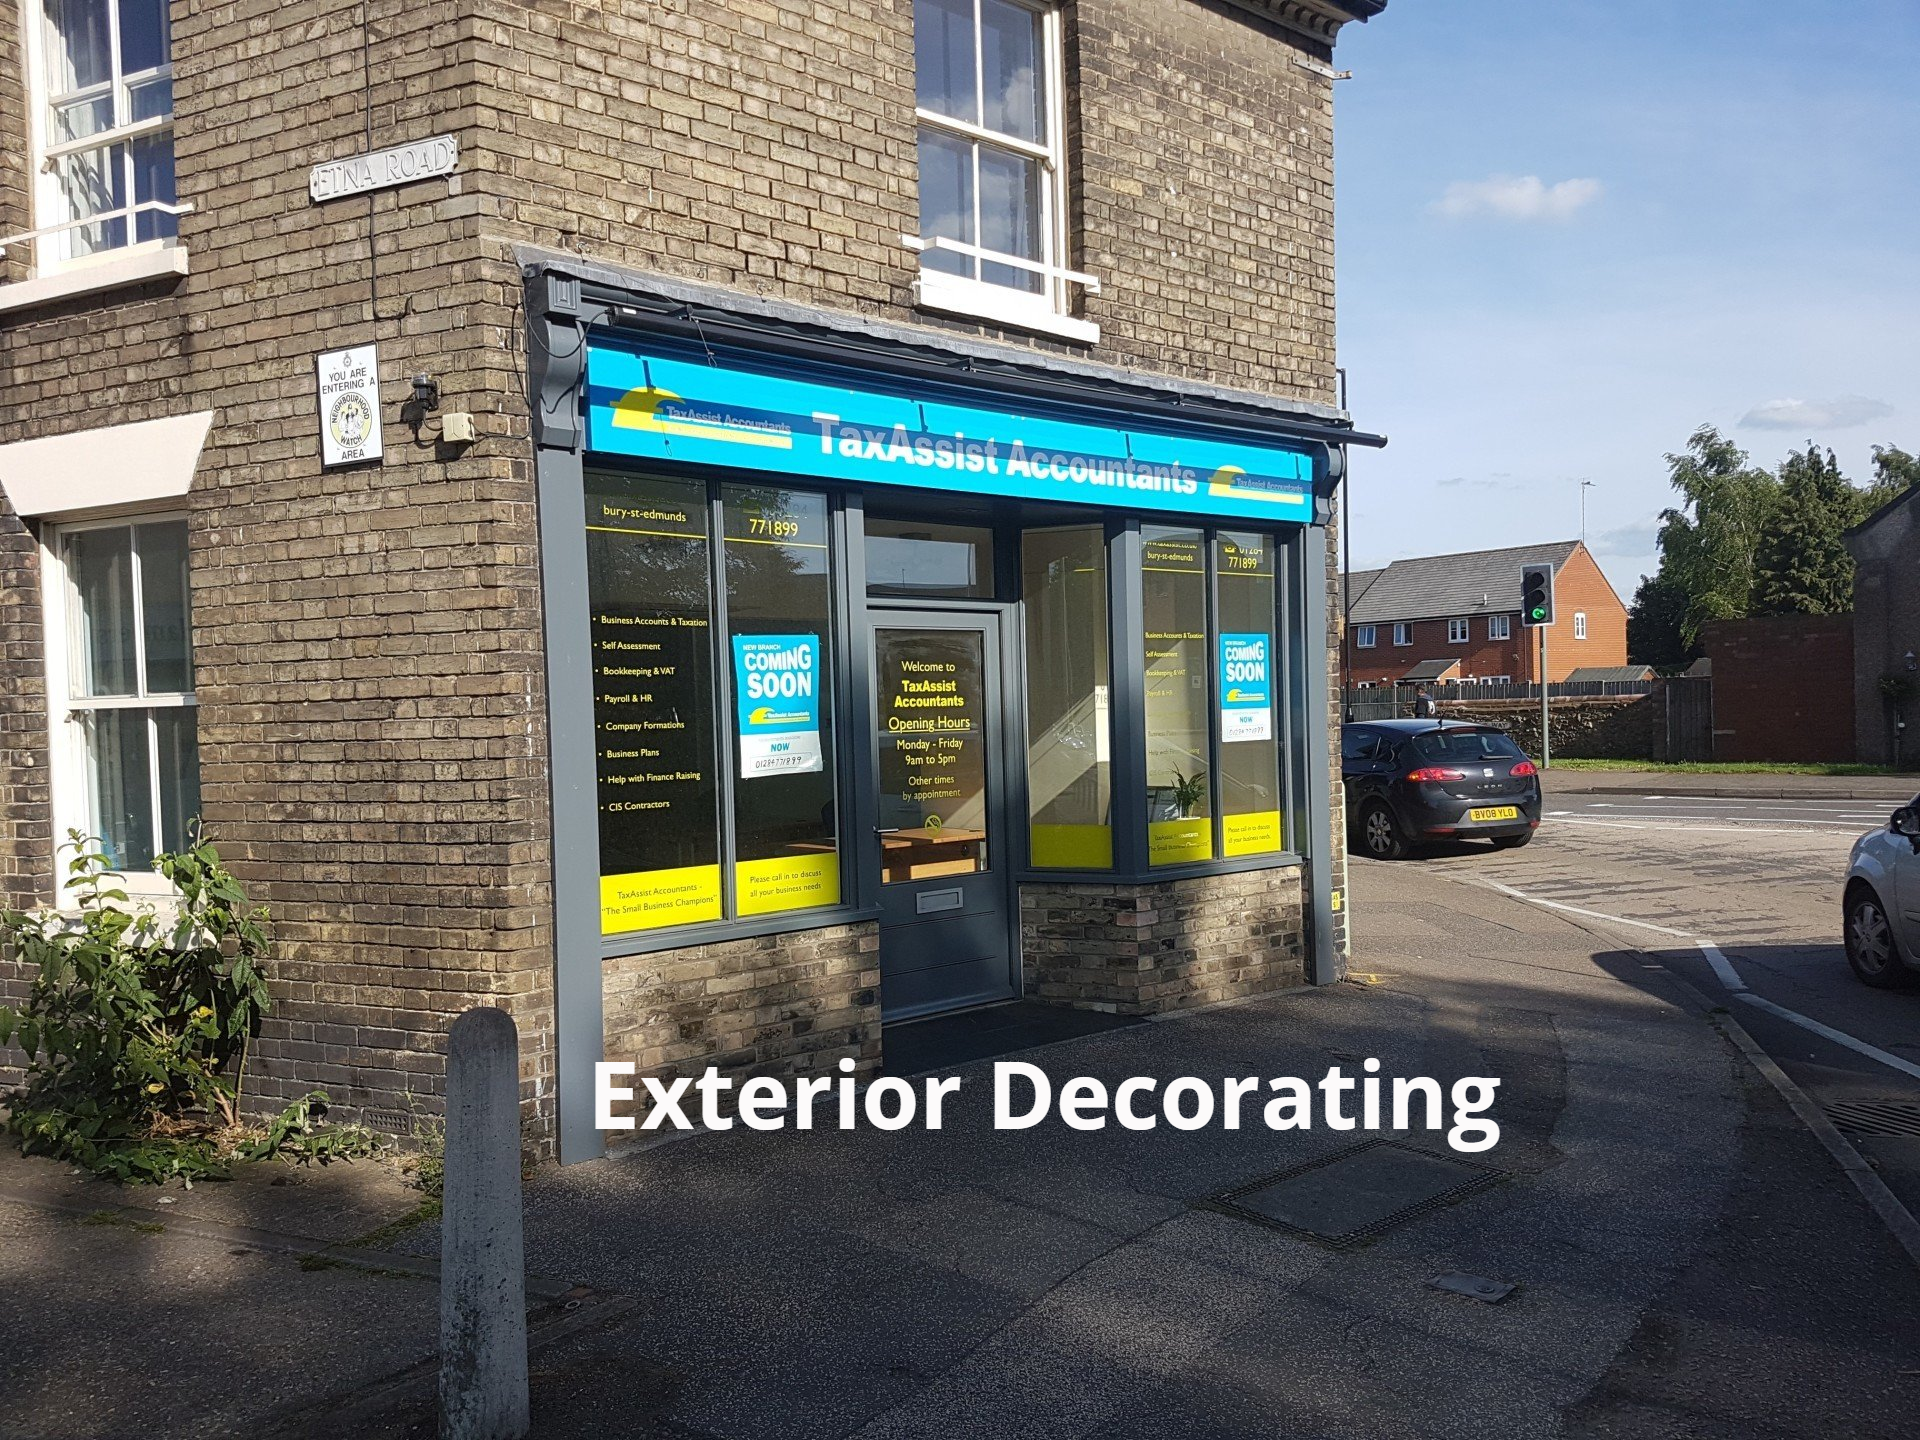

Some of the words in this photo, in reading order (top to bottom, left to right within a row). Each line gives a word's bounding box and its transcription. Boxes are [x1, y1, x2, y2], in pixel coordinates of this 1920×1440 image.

[385, 142, 451, 182] ROAD
[329, 371, 346, 382] YOU
[350, 367, 367, 378] ARE
[322, 378, 365, 394] ENTERING
[370, 377, 376, 386] A
[332, 394, 370, 424] NEIGHBOURHOOD
[666, 405, 722, 425] TaxAssist
[723, 414, 792, 435] Accountants
[340, 435, 363, 446] WATCH
[341, 448, 365, 460] AREA
[812, 411, 999, 474] TaxAssist
[1006, 440, 1198, 495] Accountants
[603, 504, 687, 522] bury-st-edmunds
[749, 518, 798, 537] 771899
[1147, 551, 1194, 561] bury-st-edmunds
[1228, 556, 1257, 569] 771899
[601, 616, 634, 625] Business
[634, 617, 669, 626] Accounts
[677, 618, 708, 627] Taxation
[602, 641, 617, 650] Self
[617, 642, 661, 650] Assessment
[1225, 640, 1265, 661] COMING
[744, 643, 812, 671] COMING
[603, 667, 652, 677] Bookkeeping
[660, 667, 676, 675] VAT
[901, 660, 944, 672] Welcome
[945, 661, 956, 672] to
[1225, 662, 1265, 682] SOON
[747, 672, 812, 699] SOON
[901, 679, 957, 693] TaxAssist
[604, 694, 630, 705] Payroll
[640, 694, 653, 702] HR
[894, 694, 965, 708] Accountants
[606, 722, 642, 732] Company
[644, 721, 685, 730] Formations
[888, 716, 935, 733] Opening
[937, 715, 971, 729] Hours
[771, 743, 790, 752] NOW
[896, 739, 930, 751] Monday
[938, 738, 964, 750] Friday
[606, 750, 639, 759] Business
[640, 749, 660, 757] Plans
[905, 755, 924, 766] 9am
[926, 755, 936, 765] to
[937, 753, 956, 766] 5pm
[607, 775, 626, 785] Help
[628, 774, 645, 783] with
[646, 773, 674, 782] Finance
[676, 771, 701, 780] Raising
[908, 776, 933, 786] Other
[934, 775, 955, 785] times
[902, 791, 912, 803] by
[913, 789, 961, 801] appointment
[608, 803, 623, 811] CIS
[624, 801, 670, 810] Contractors
[1474, 809, 1497, 819] BV08
[1498, 808, 1514, 817] YLO
[771, 873, 783, 881] call
[800, 870, 822, 878] discuss
[617, 890, 651, 899] TaxAssist
[653, 884, 697, 895] Accountants
[759, 889, 774, 898] your
[775, 886, 802, 894] business
[803, 882, 822, 891] needs
[622, 904, 642, 913] Small
[643, 902, 674, 911] Business
